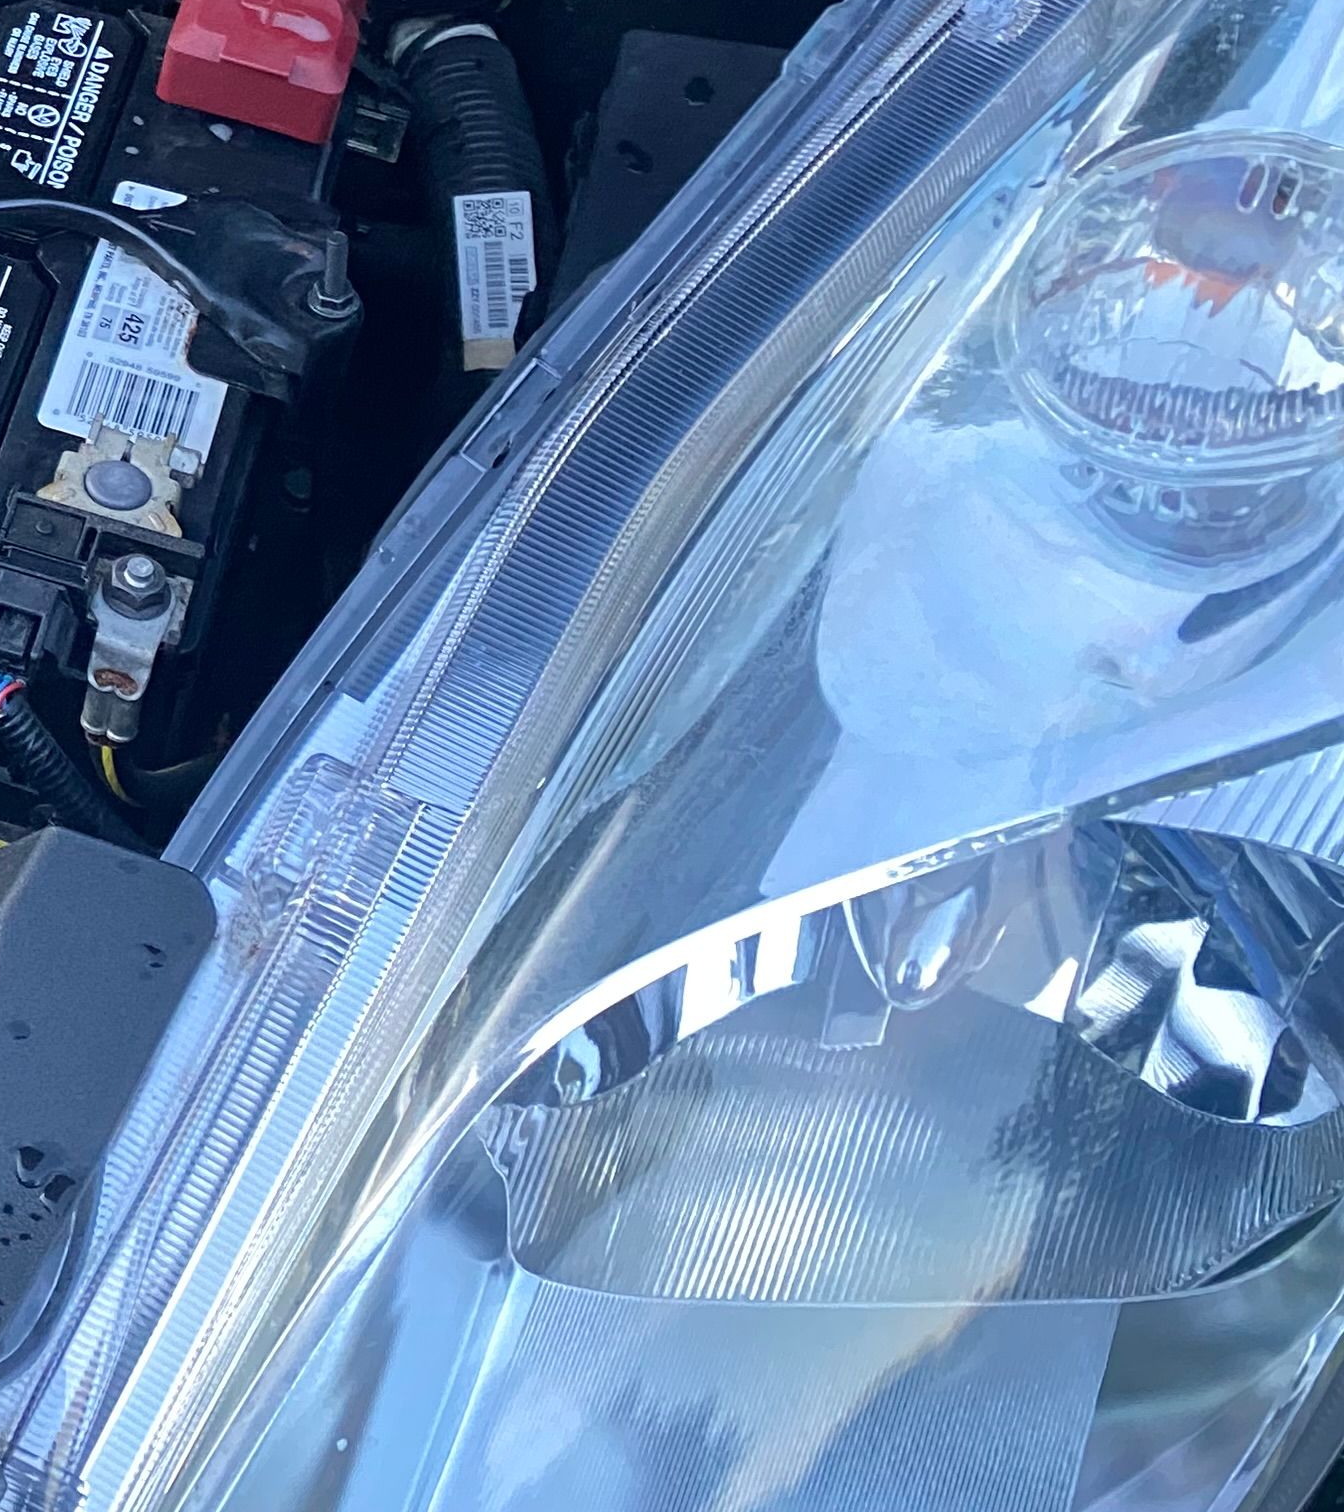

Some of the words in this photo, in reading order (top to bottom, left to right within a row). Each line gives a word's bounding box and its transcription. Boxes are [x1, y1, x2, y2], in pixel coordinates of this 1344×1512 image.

[24, 33, 46, 60] GASES
[30, 36, 58, 79] EXPLOSIVE
[44, 55, 63, 77] EYES
[53, 59, 76, 88] SHIELD
[69, 60, 110, 123] DANGER
[12, 101, 29, 116] NO
[509, 220, 523, 240] F2
[98, 313, 112, 332] 75
[118, 313, 146, 346] 425
